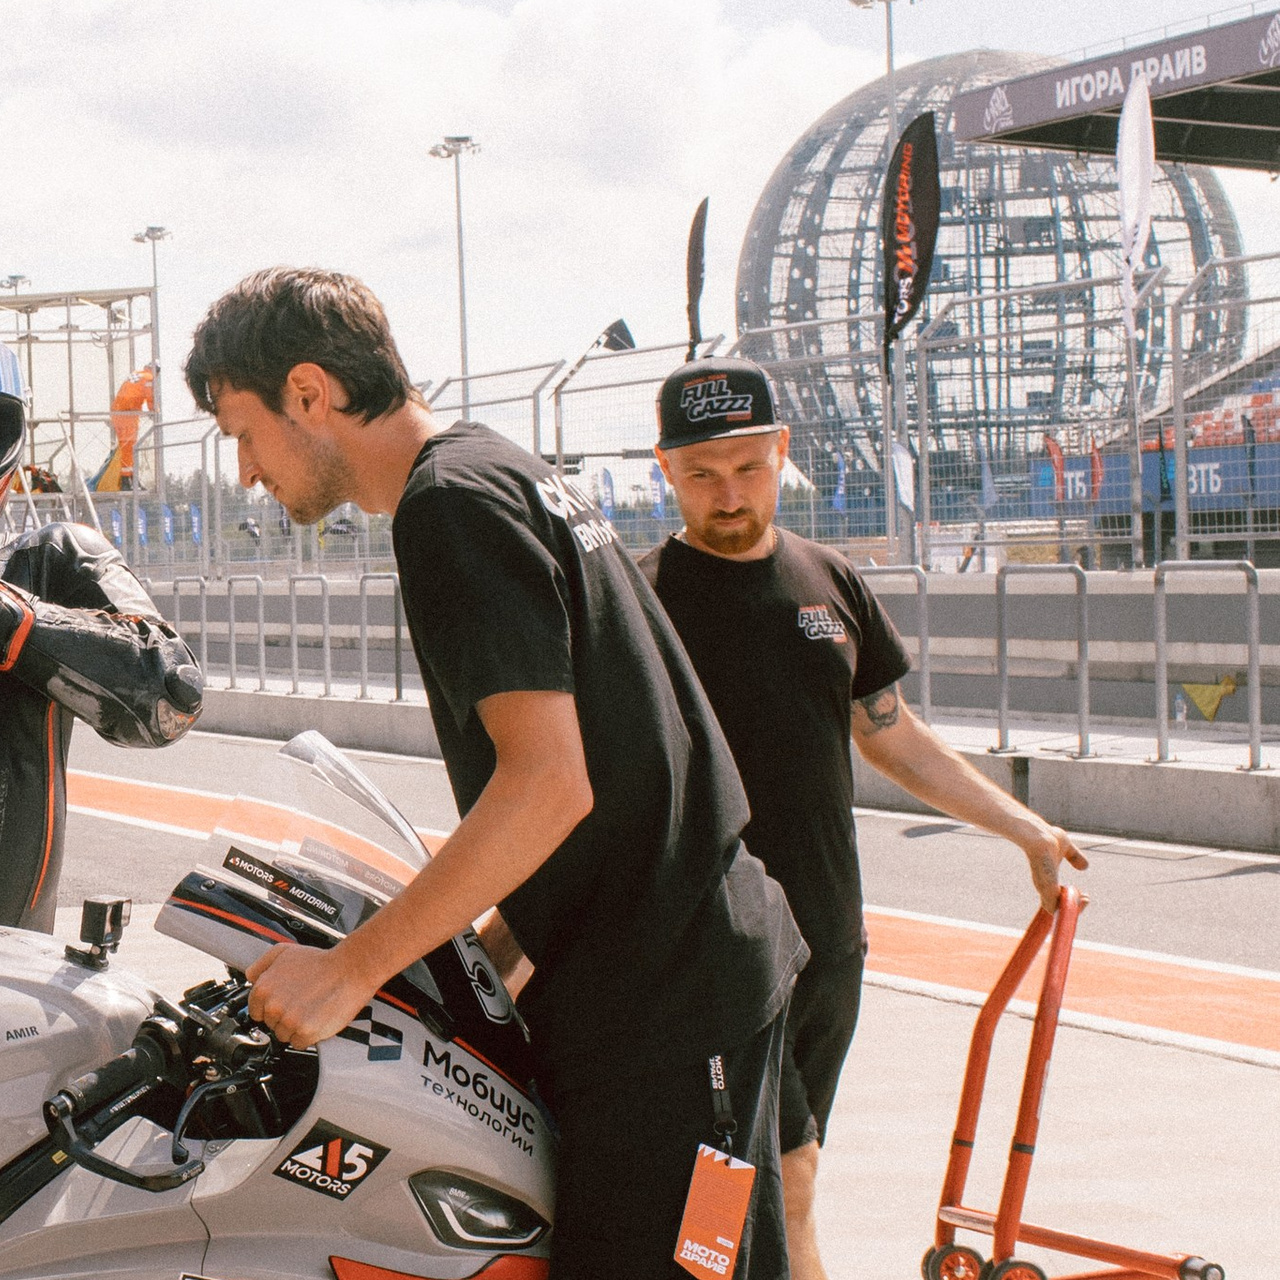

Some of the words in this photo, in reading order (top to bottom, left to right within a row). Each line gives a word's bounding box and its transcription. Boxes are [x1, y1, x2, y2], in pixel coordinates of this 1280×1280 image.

[1056, 66, 1124, 108] ИГОРА
[681, 380, 732, 408] FULL
[1058, 471, 1087, 499] ТБ
[798, 609, 832, 627] FULL
[239, 861, 275, 884] MOTORS
[288, 885, 337, 917] MOTORING
[5, 1025, 39, 1041] AMIR
[422, 1039, 538, 1136] Мобиус
[714, 1055, 725, 1090] МОТО
[420, 1073, 535, 1158] технологии
[280, 1159, 352, 1195] MOTORS
[682, 1238, 731, 1267] МОТО
